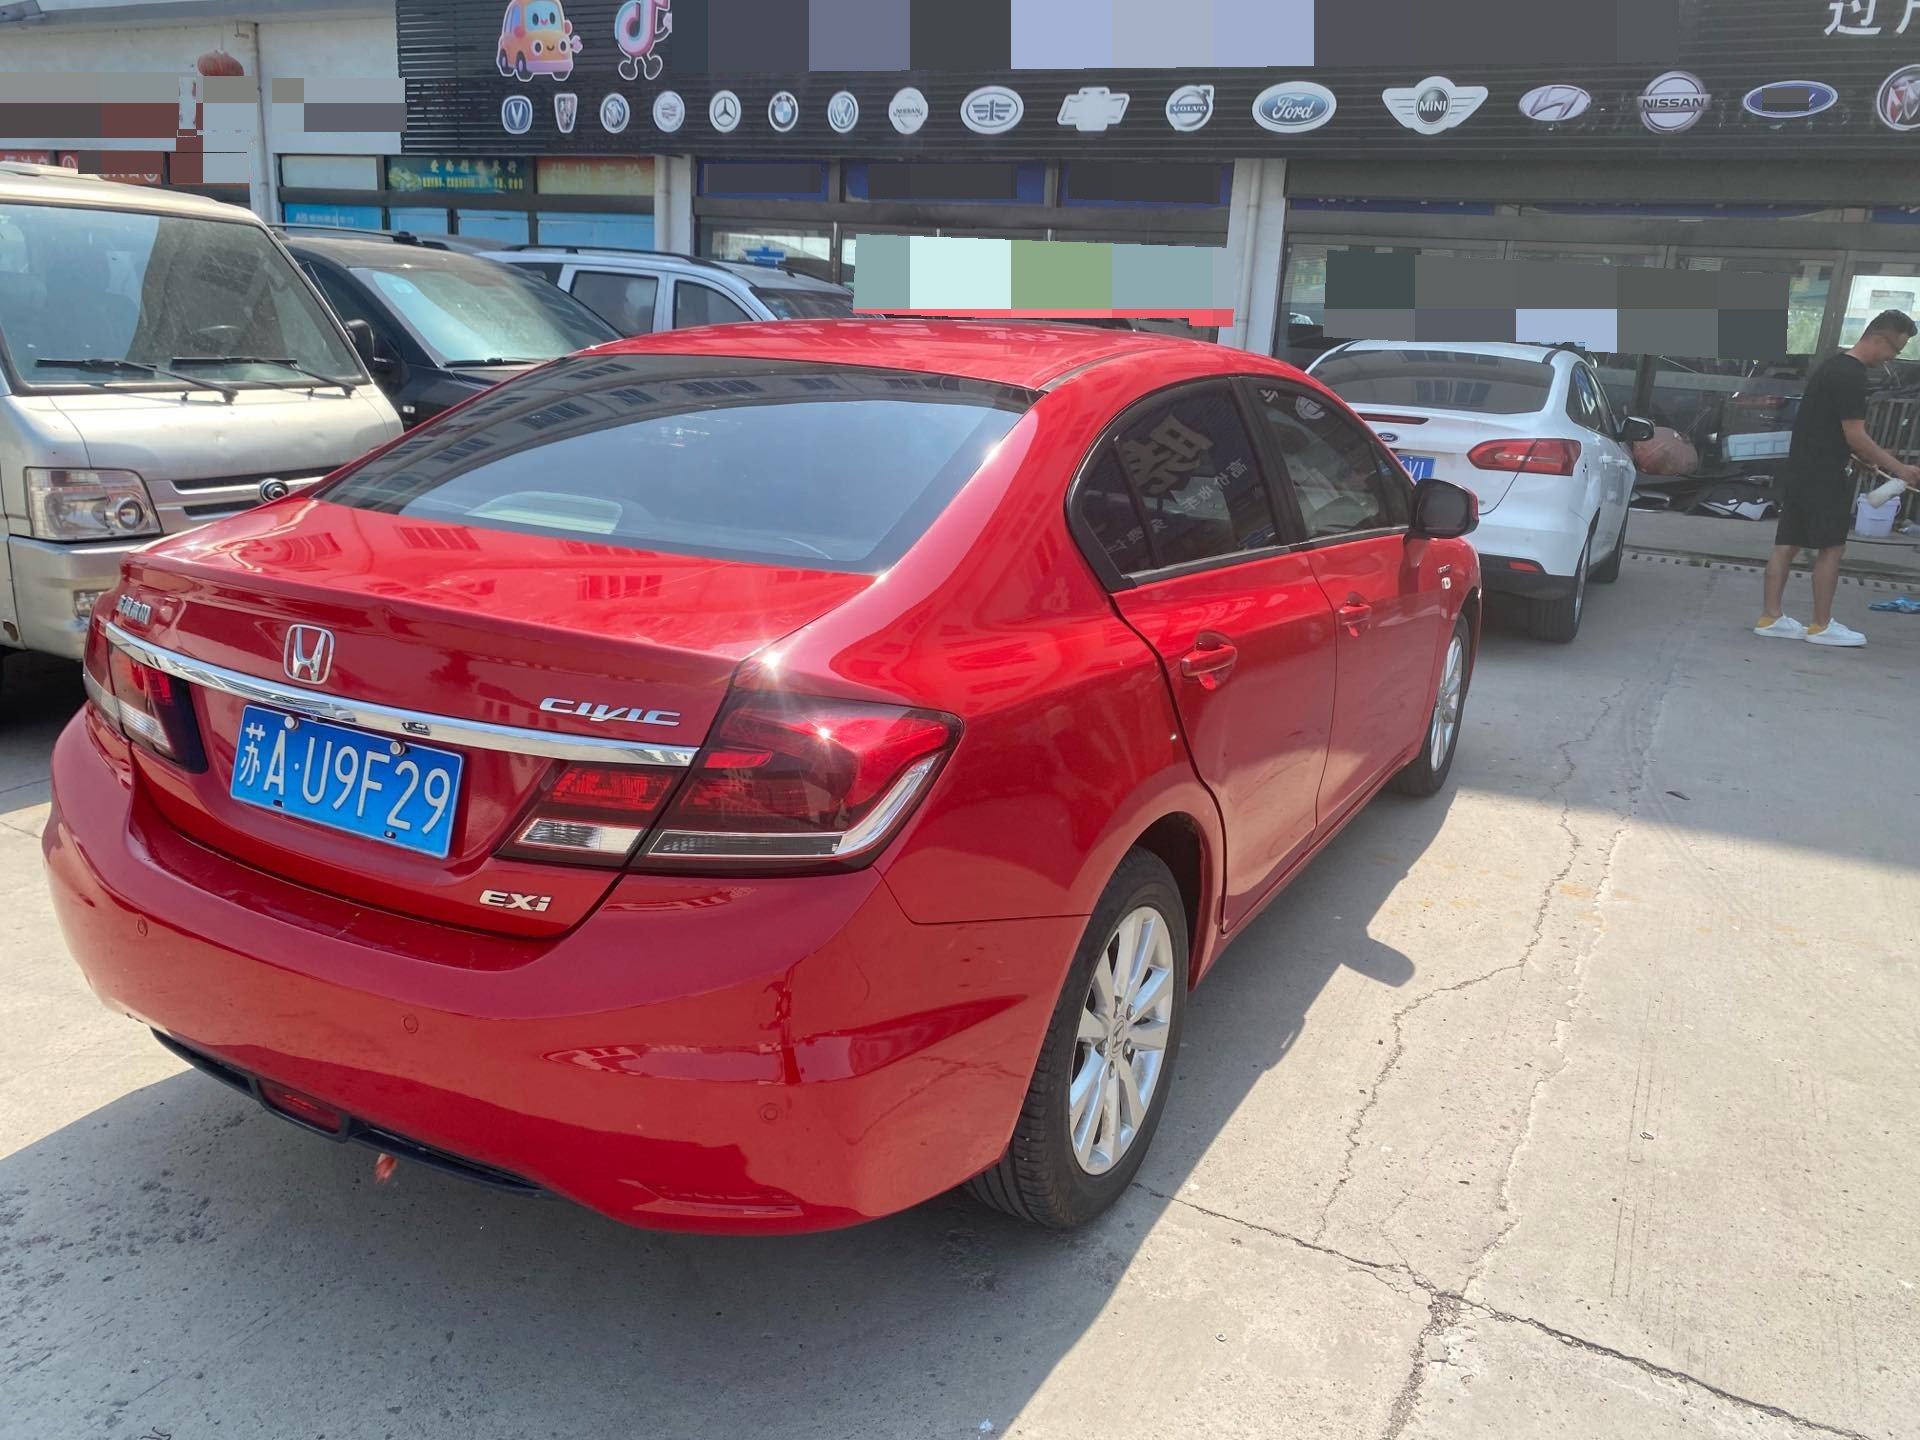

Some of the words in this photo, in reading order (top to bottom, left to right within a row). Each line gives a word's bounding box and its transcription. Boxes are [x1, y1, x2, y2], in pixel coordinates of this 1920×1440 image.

[1173, 104, 1207, 112] VOLVO
[1272, 97, 1314, 119] Ford
[1420, 100, 1447, 111] MINI
[1642, 98, 1704, 108] NISSAN
[540, 697, 681, 727] CIVIC
[239, 722, 451, 834] 苏A·U9F29
[479, 889, 551, 912] EXi
